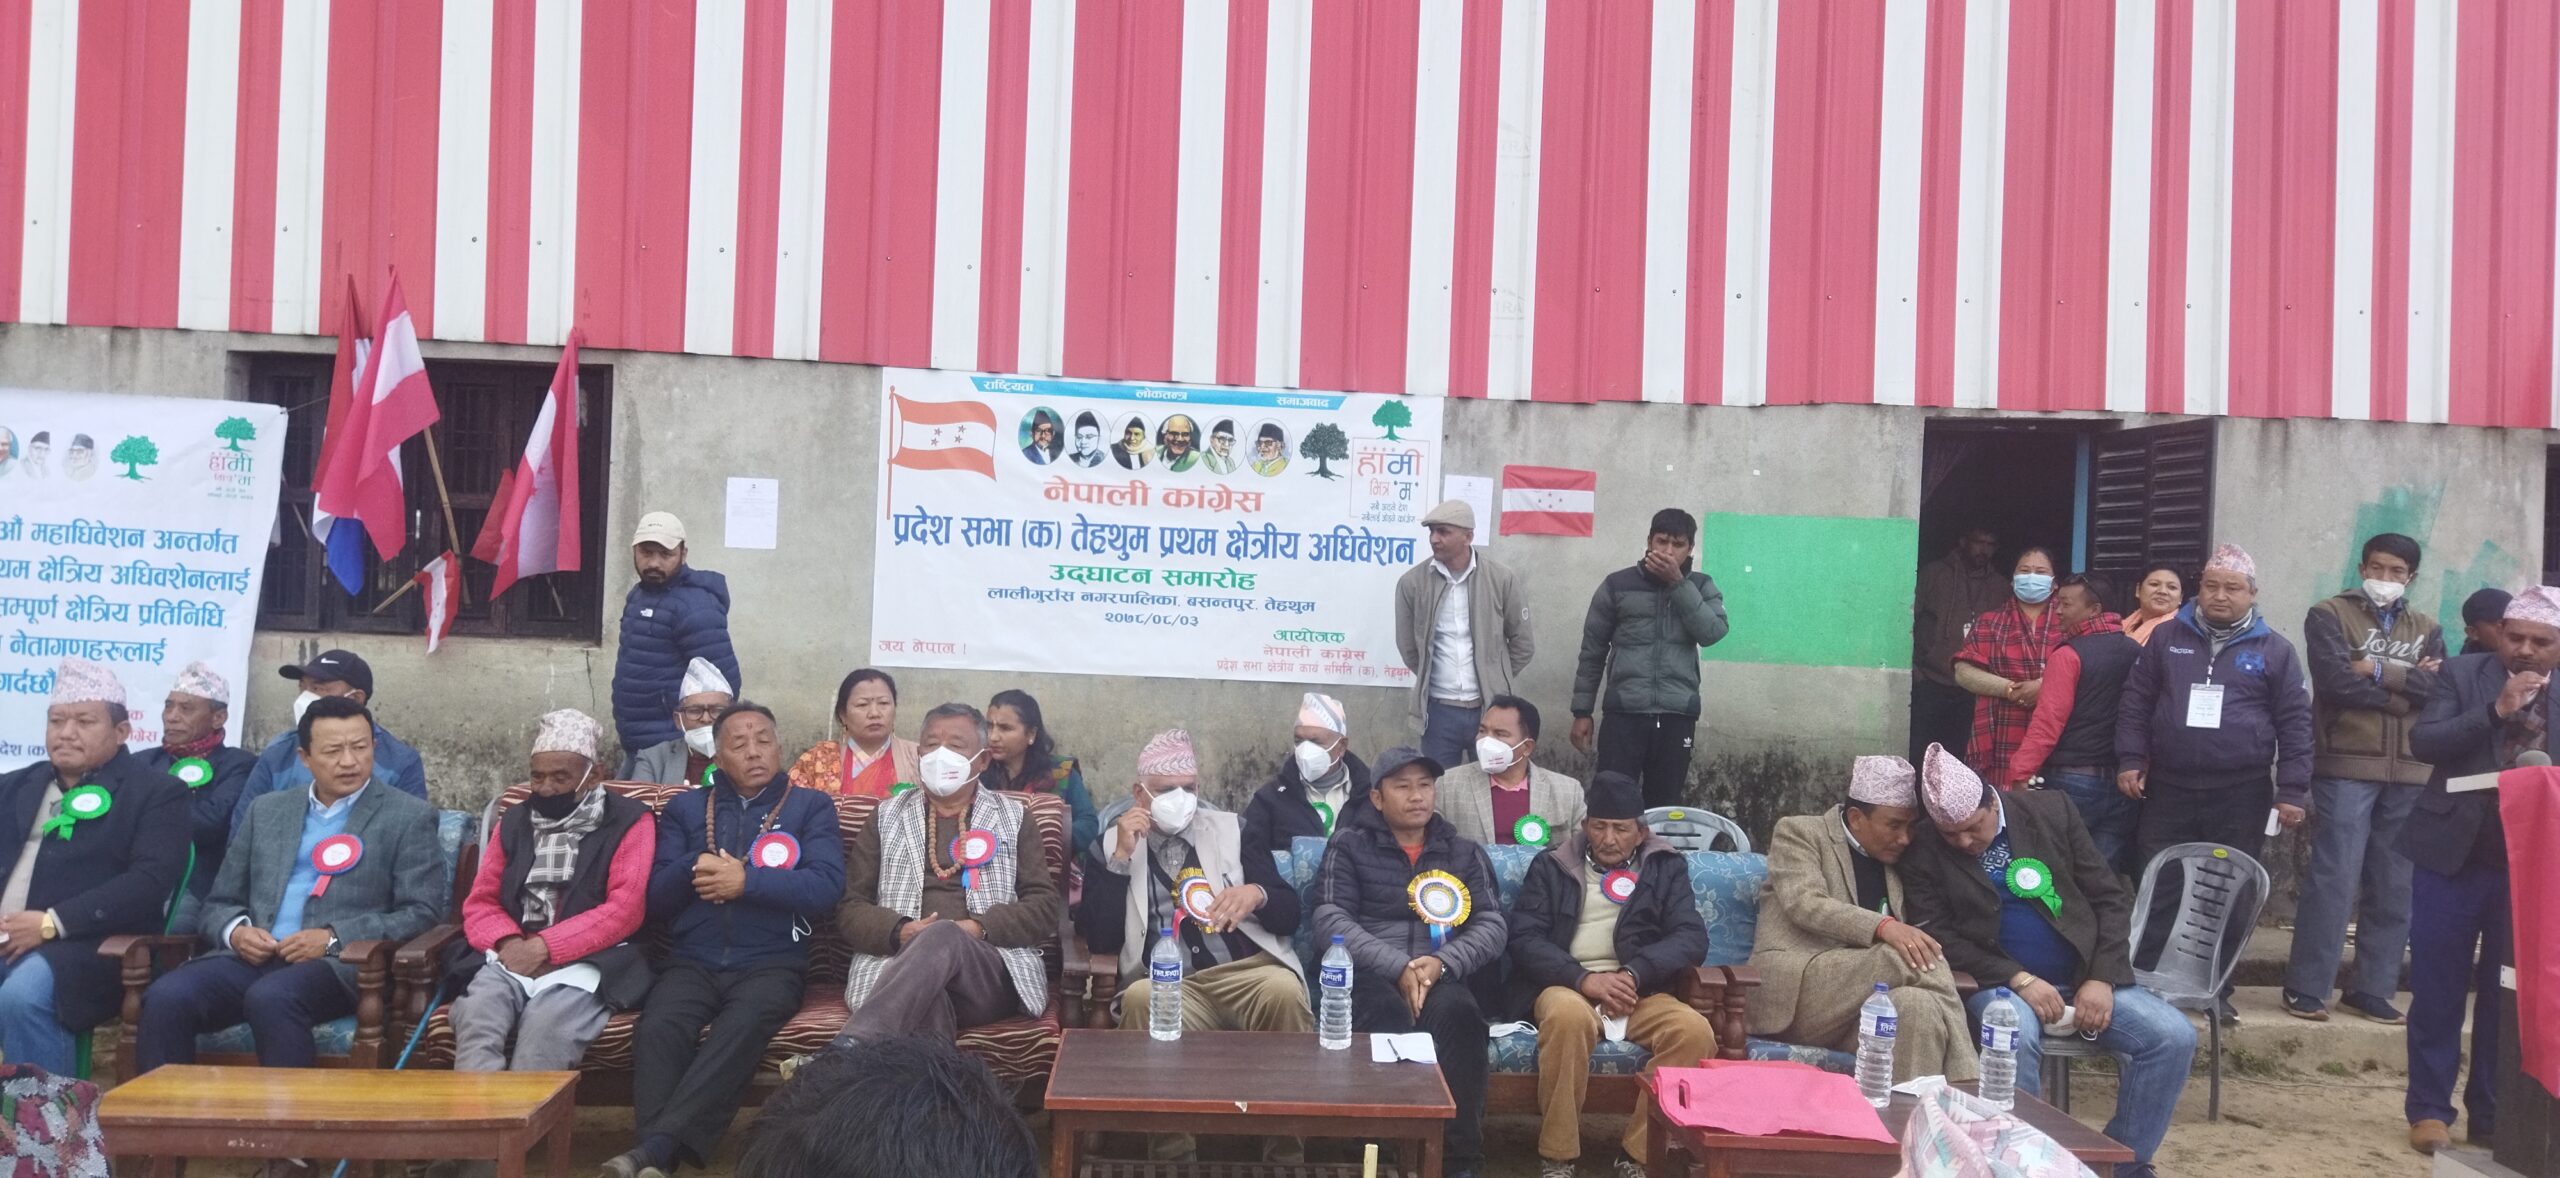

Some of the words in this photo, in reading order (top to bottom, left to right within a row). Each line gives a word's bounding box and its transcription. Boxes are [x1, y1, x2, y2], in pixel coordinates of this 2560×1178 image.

[1276, 396, 1330, 408] समाजवाद
[1357, 448, 1424, 476] हामी
[1043, 475, 1152, 507] नेपाली
[1162, 483, 1264, 513] कांग्रेस
[31, 518, 146, 549] महाधिवेशन
[153, 528, 240, 554] अन्तर्गत
[893, 505, 953, 546] प्रदेश
[961, 516, 1013, 548] सभा
[1021, 519, 1062, 550] (क)
[1159, 525, 1218, 558] प्रथम
[1226, 520, 1301, 561] क्षेत्रीय
[1308, 523, 1416, 566] अधिवेशन
[38, 555, 104, 583] क्षेत्रिय
[1162, 566, 1257, 590] समारोह
[65, 595, 131, 623] क्षेत्रिय
[1105, 612, 1199, 627] २०७८/०८/०३
[878, 639, 905, 653] जय
[912, 638, 956, 655] नेपाल
[1273, 628, 1346, 644] आयोजक
[1264, 643, 1313, 660] नेपाली
